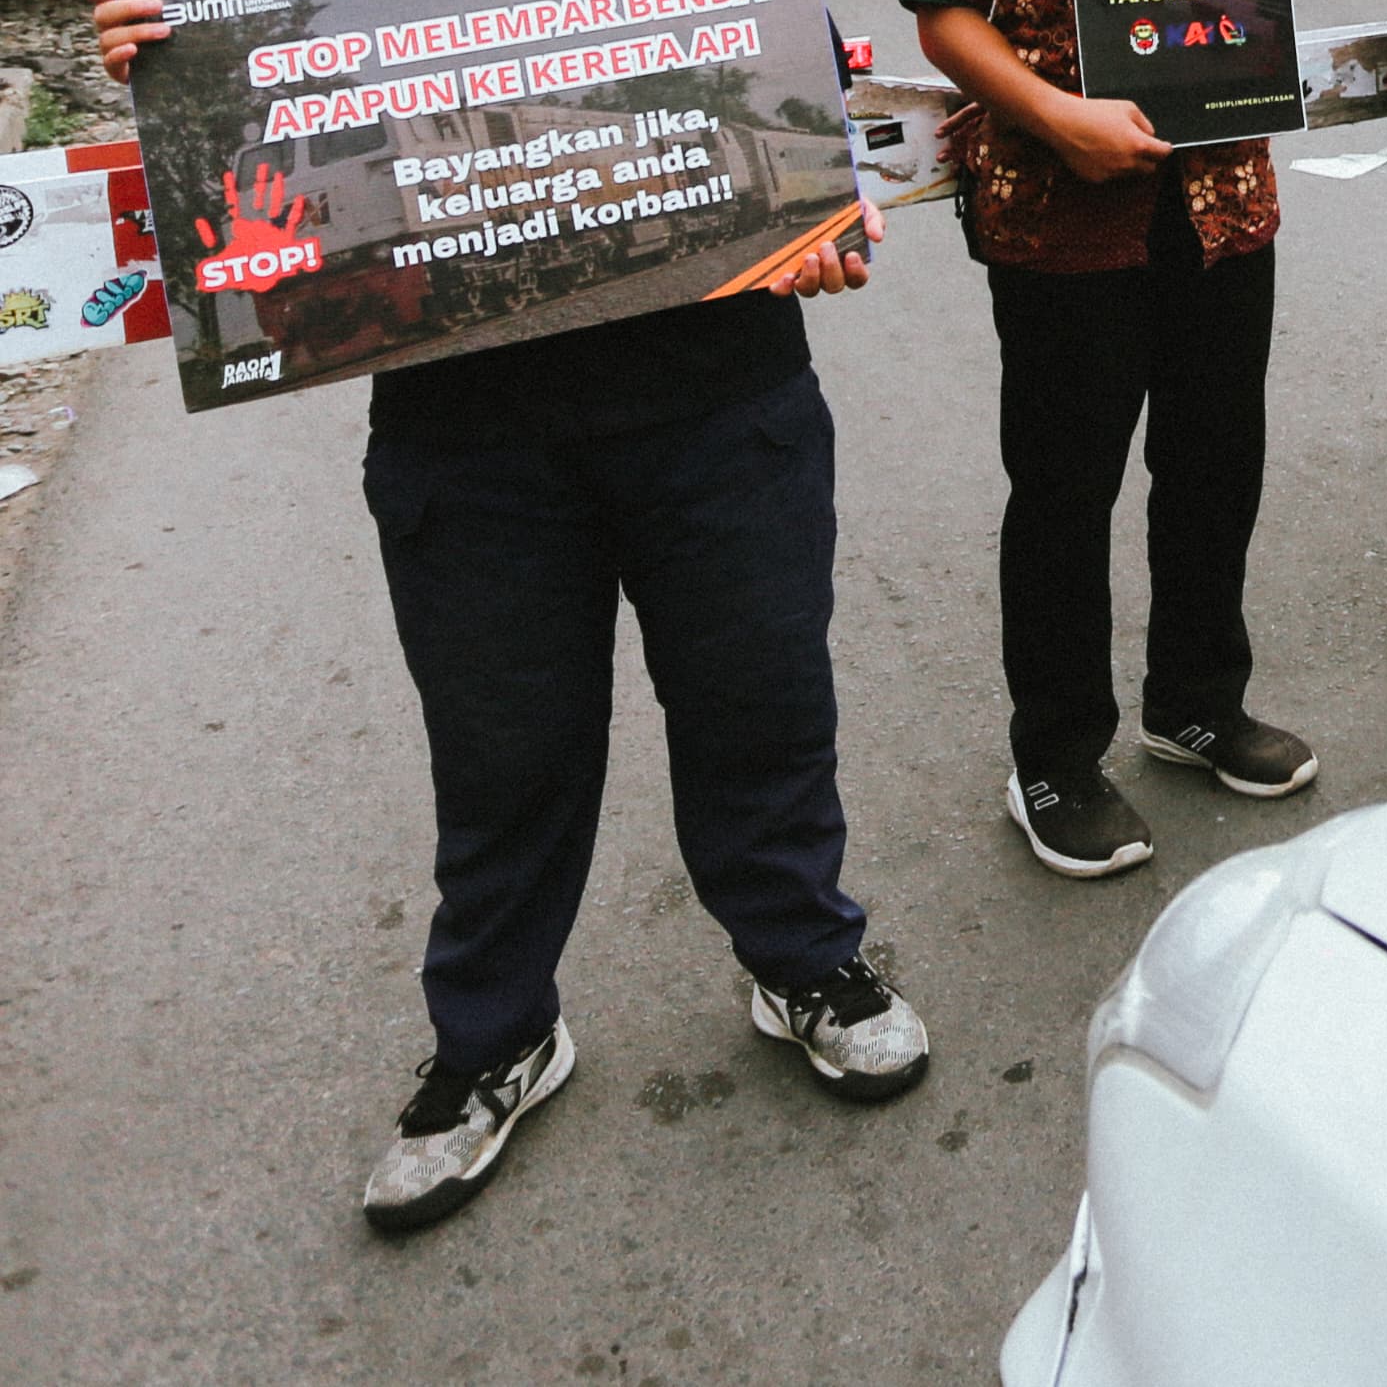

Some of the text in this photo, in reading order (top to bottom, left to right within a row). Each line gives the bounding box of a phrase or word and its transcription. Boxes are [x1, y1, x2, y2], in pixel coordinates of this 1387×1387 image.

[246, 0, 292, 14] INDONESIA
[249, 32, 373, 89] STOP
[1166, 21, 1215, 48] KAI
[263, 17, 762, 142] APAPUN KE KERETA API
[1205, 93, 1294, 110] #DISIPLINPERLINTASAN
[393, 107, 720, 188] Bayangkan jika,
[418, 142, 711, 223] keluarga anda
[393, 174, 734, 269] menjadi korban!!
[201, 240, 321, 288] STOP!
[225, 356, 270, 376] DAOP
